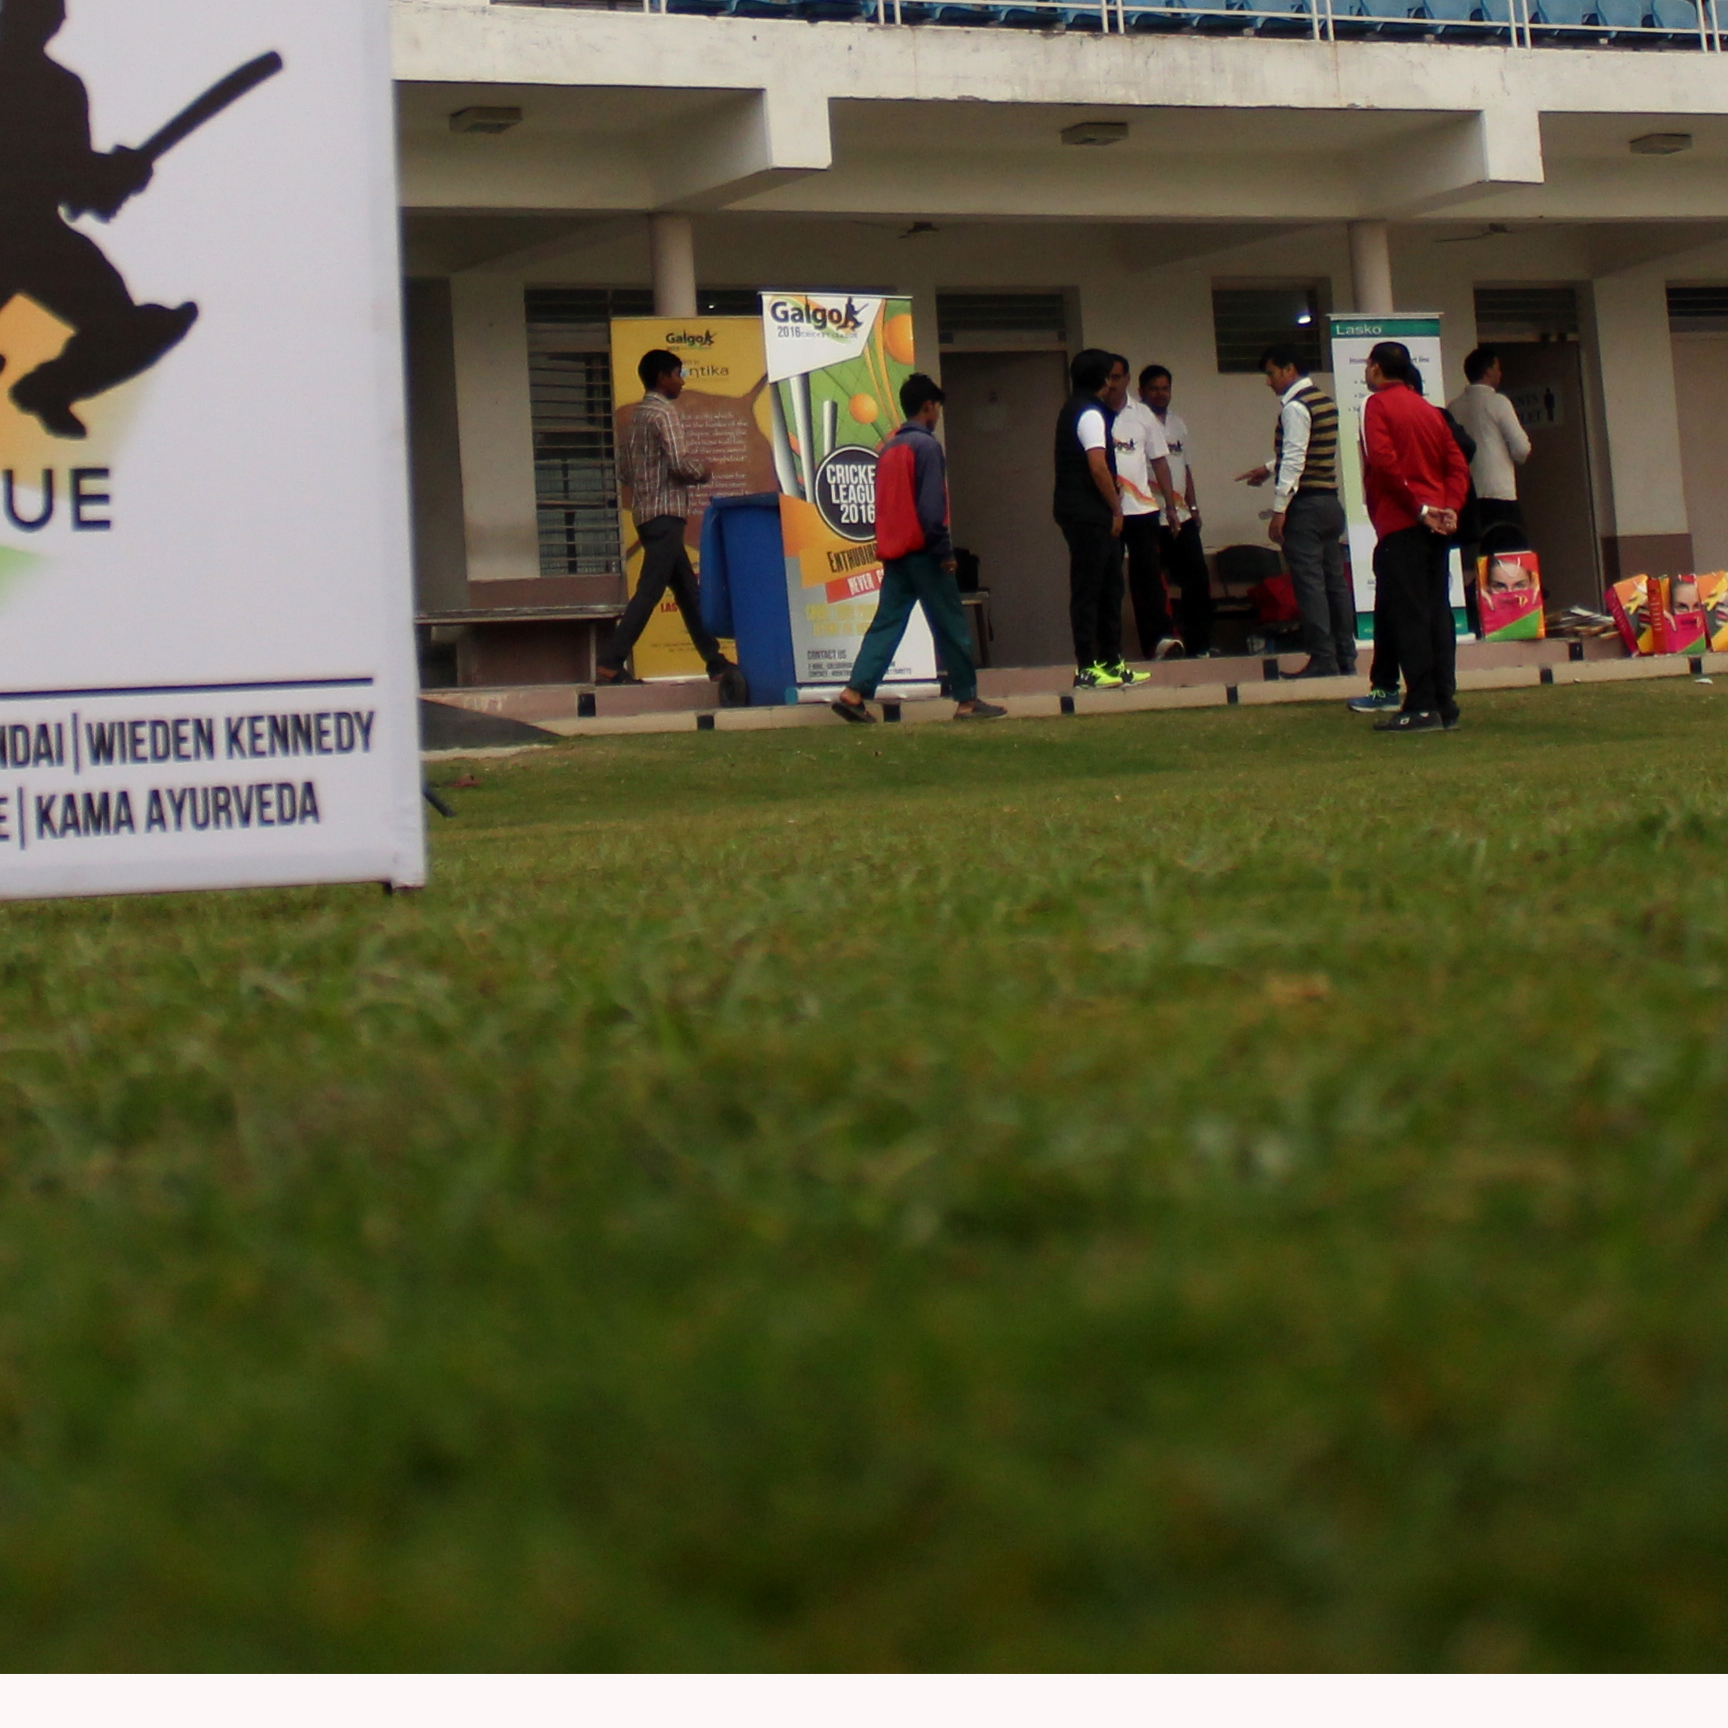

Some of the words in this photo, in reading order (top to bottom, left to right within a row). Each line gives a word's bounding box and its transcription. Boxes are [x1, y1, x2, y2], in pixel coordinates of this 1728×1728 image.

[770, 295, 843, 330] Galgo
[665, 329, 704, 346] Galgo
[1335, 324, 1382, 335] Lasko
[827, 464, 876, 485] CRICKE
[831, 484, 876, 504] LEAGU
[840, 503, 876, 524] 2016
[85, 718, 215, 766] WIEDEN
[224, 710, 376, 760] KENNEDY
[35, 789, 137, 841] KAMA
[144, 780, 321, 834] AYURVEDA
